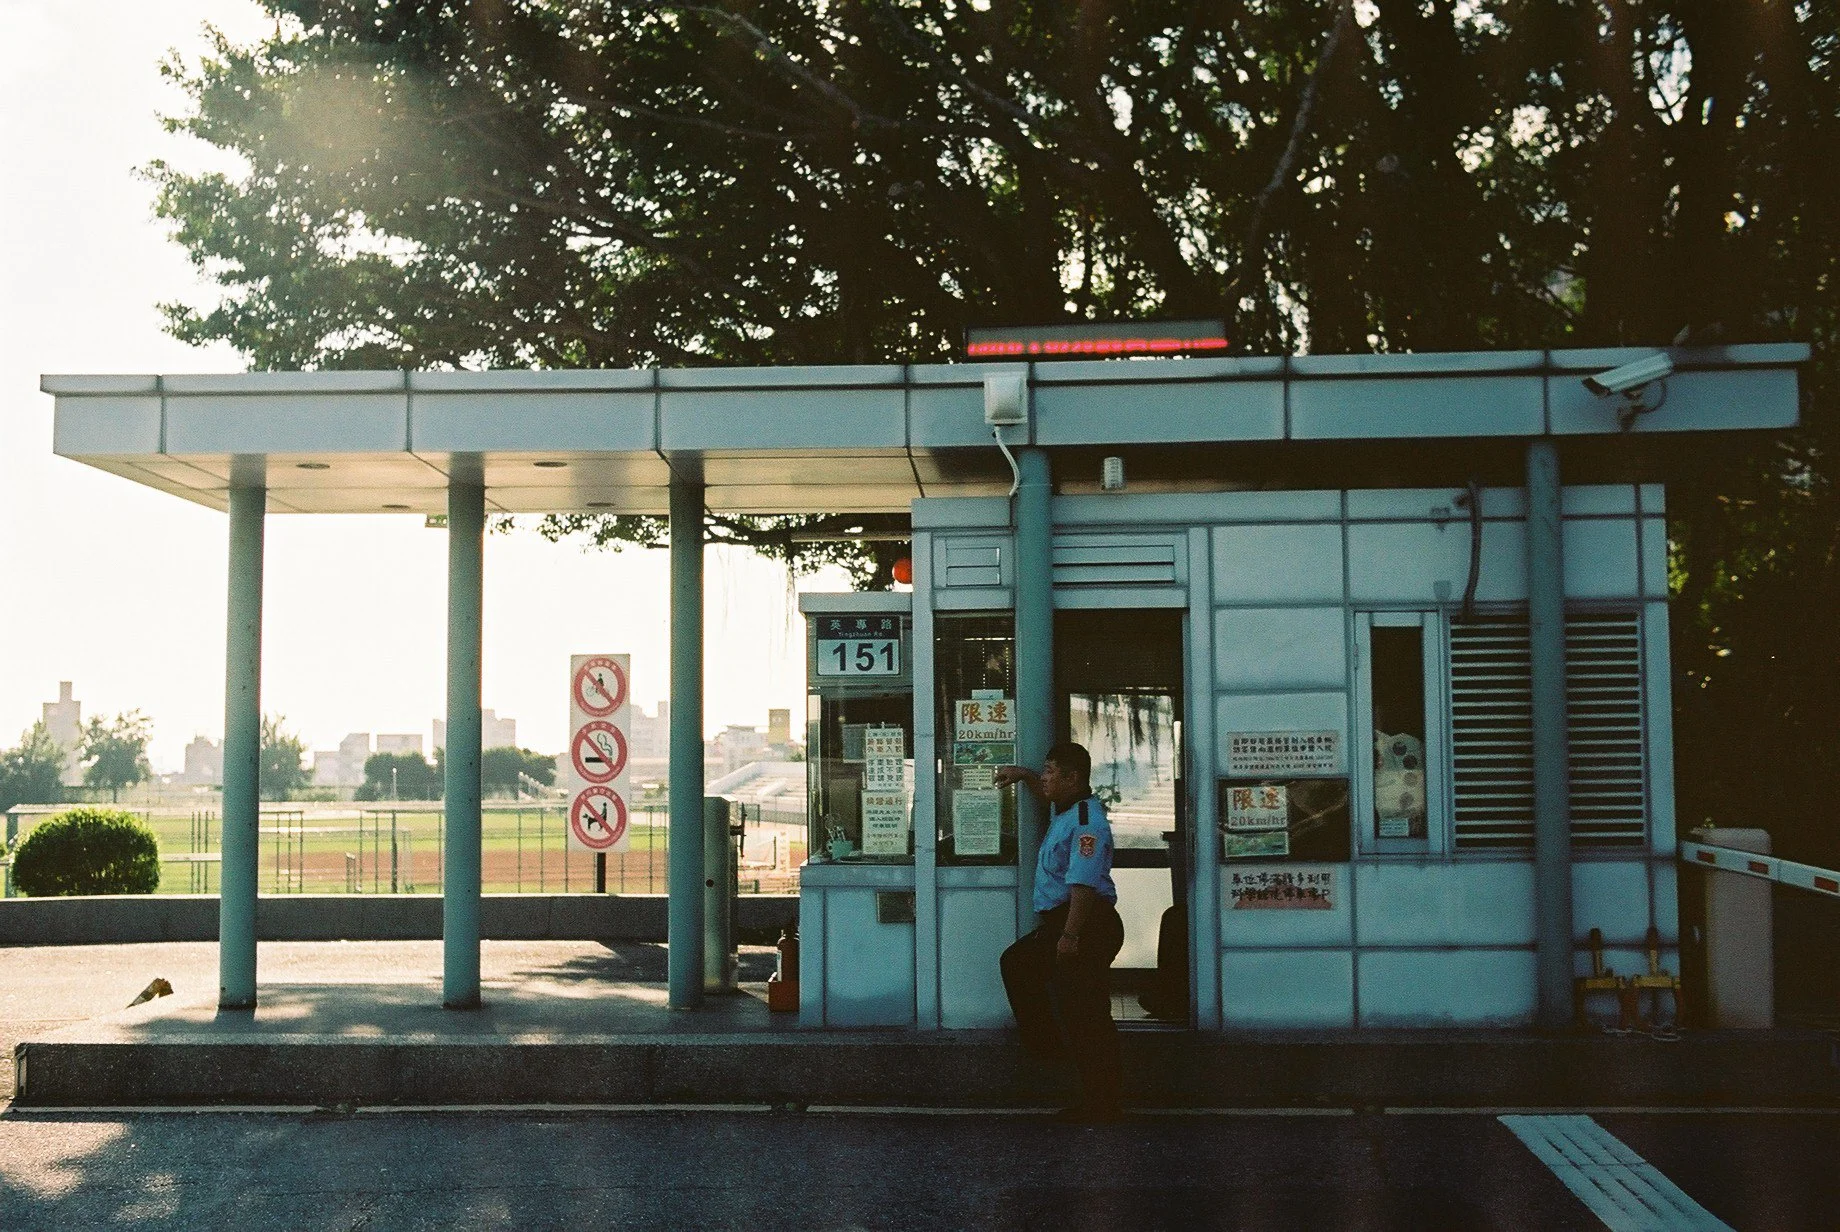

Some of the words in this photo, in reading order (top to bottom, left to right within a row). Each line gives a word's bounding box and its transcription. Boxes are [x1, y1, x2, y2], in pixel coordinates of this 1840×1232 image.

[832, 642, 894, 672] 151
[961, 700, 1010, 726] 限速
[957, 728, 1014, 741] 20km/hr
[1232, 786, 1281, 811] 限速
[1230, 815, 1286, 827] 20km/hr
